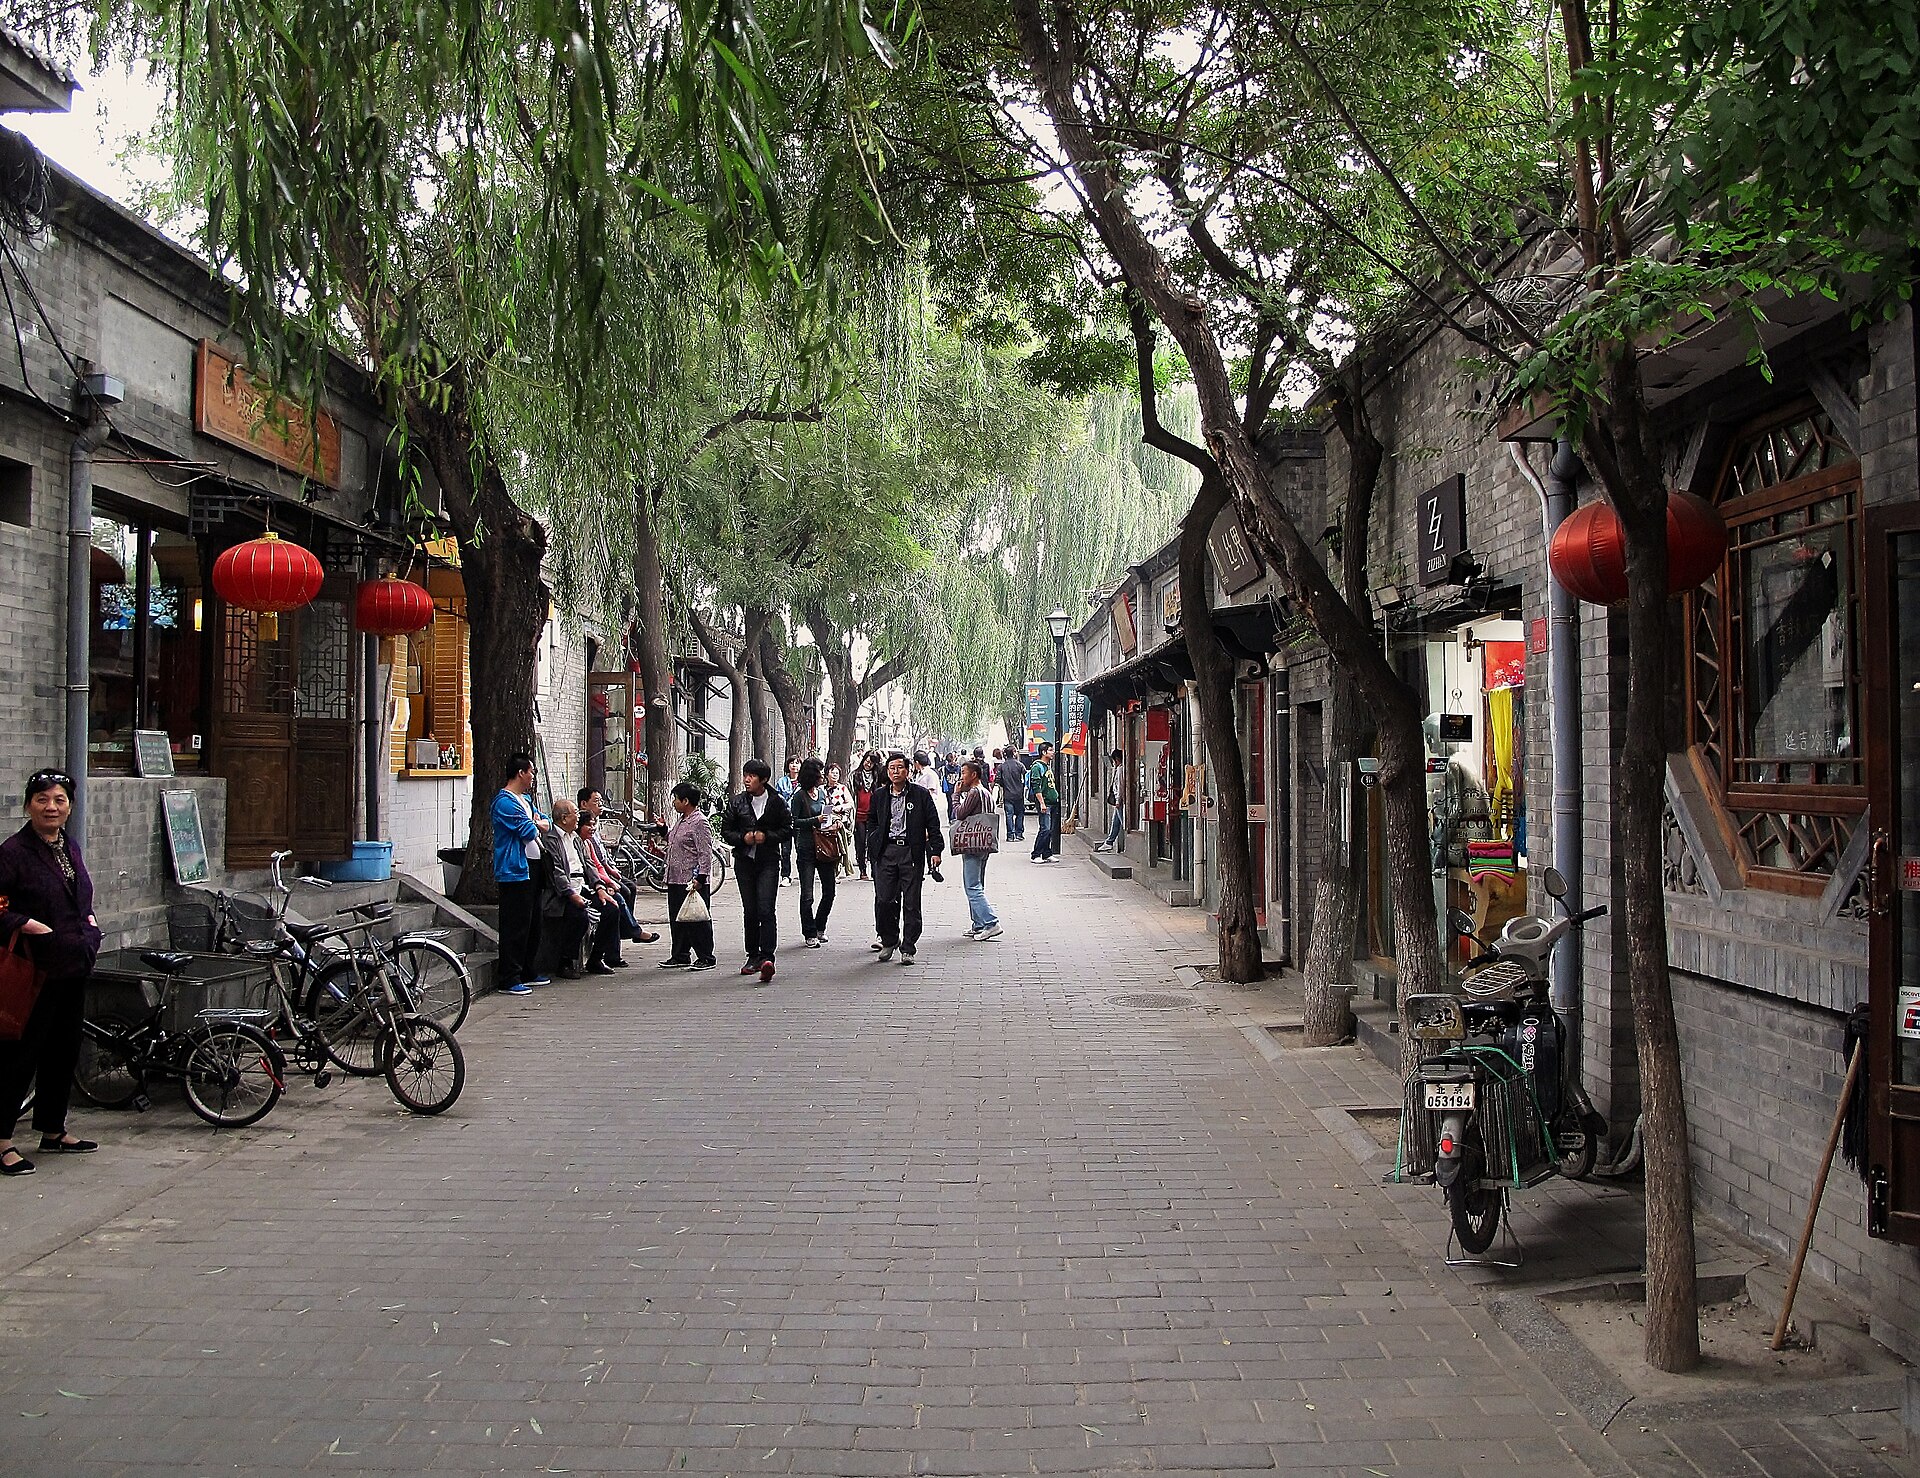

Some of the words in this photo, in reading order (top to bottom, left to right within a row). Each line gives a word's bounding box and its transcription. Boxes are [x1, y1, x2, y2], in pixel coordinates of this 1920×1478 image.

[953, 832, 993, 848] ELETTIVO
[1436, 1084, 1463, 1095] 北京
[1427, 1095, 1471, 1107] 053194
